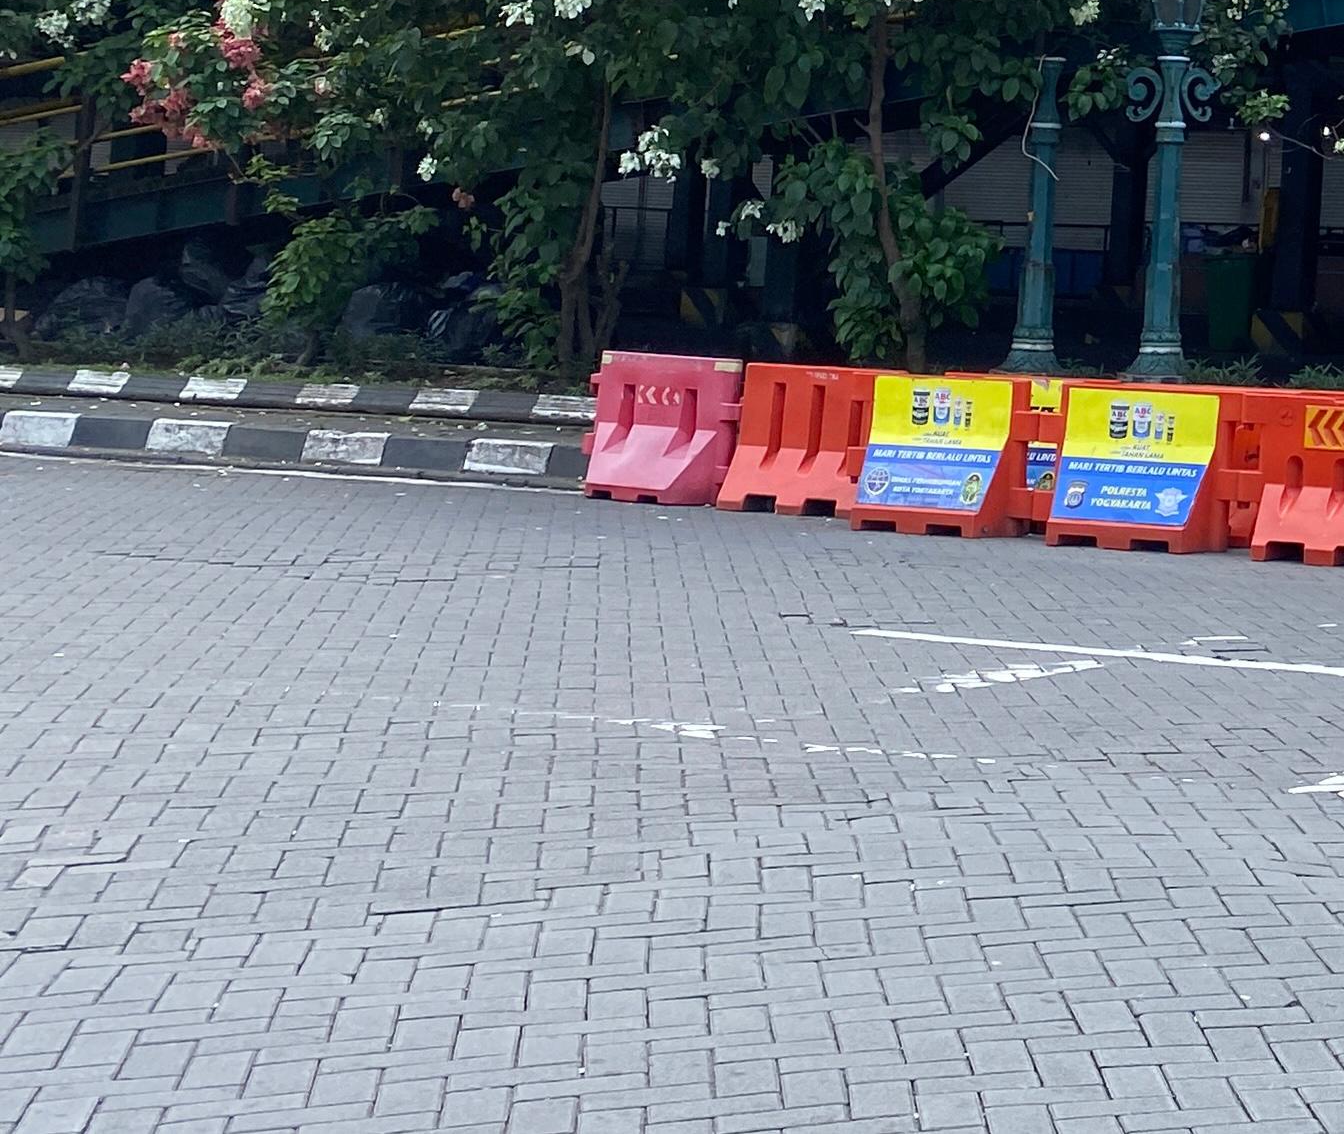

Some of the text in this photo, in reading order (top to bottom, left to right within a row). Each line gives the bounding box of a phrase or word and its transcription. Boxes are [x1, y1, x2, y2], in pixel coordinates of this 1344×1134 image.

[873, 449, 992, 463] MARI TERTIB BERLALU LINTAS
[1068, 461, 1198, 477] MARI TERTIB BERLALU LINTAS
[1100, 485, 1147, 496] POLRESTA
[1090, 498, 1152, 510] YOGYAKARTA
